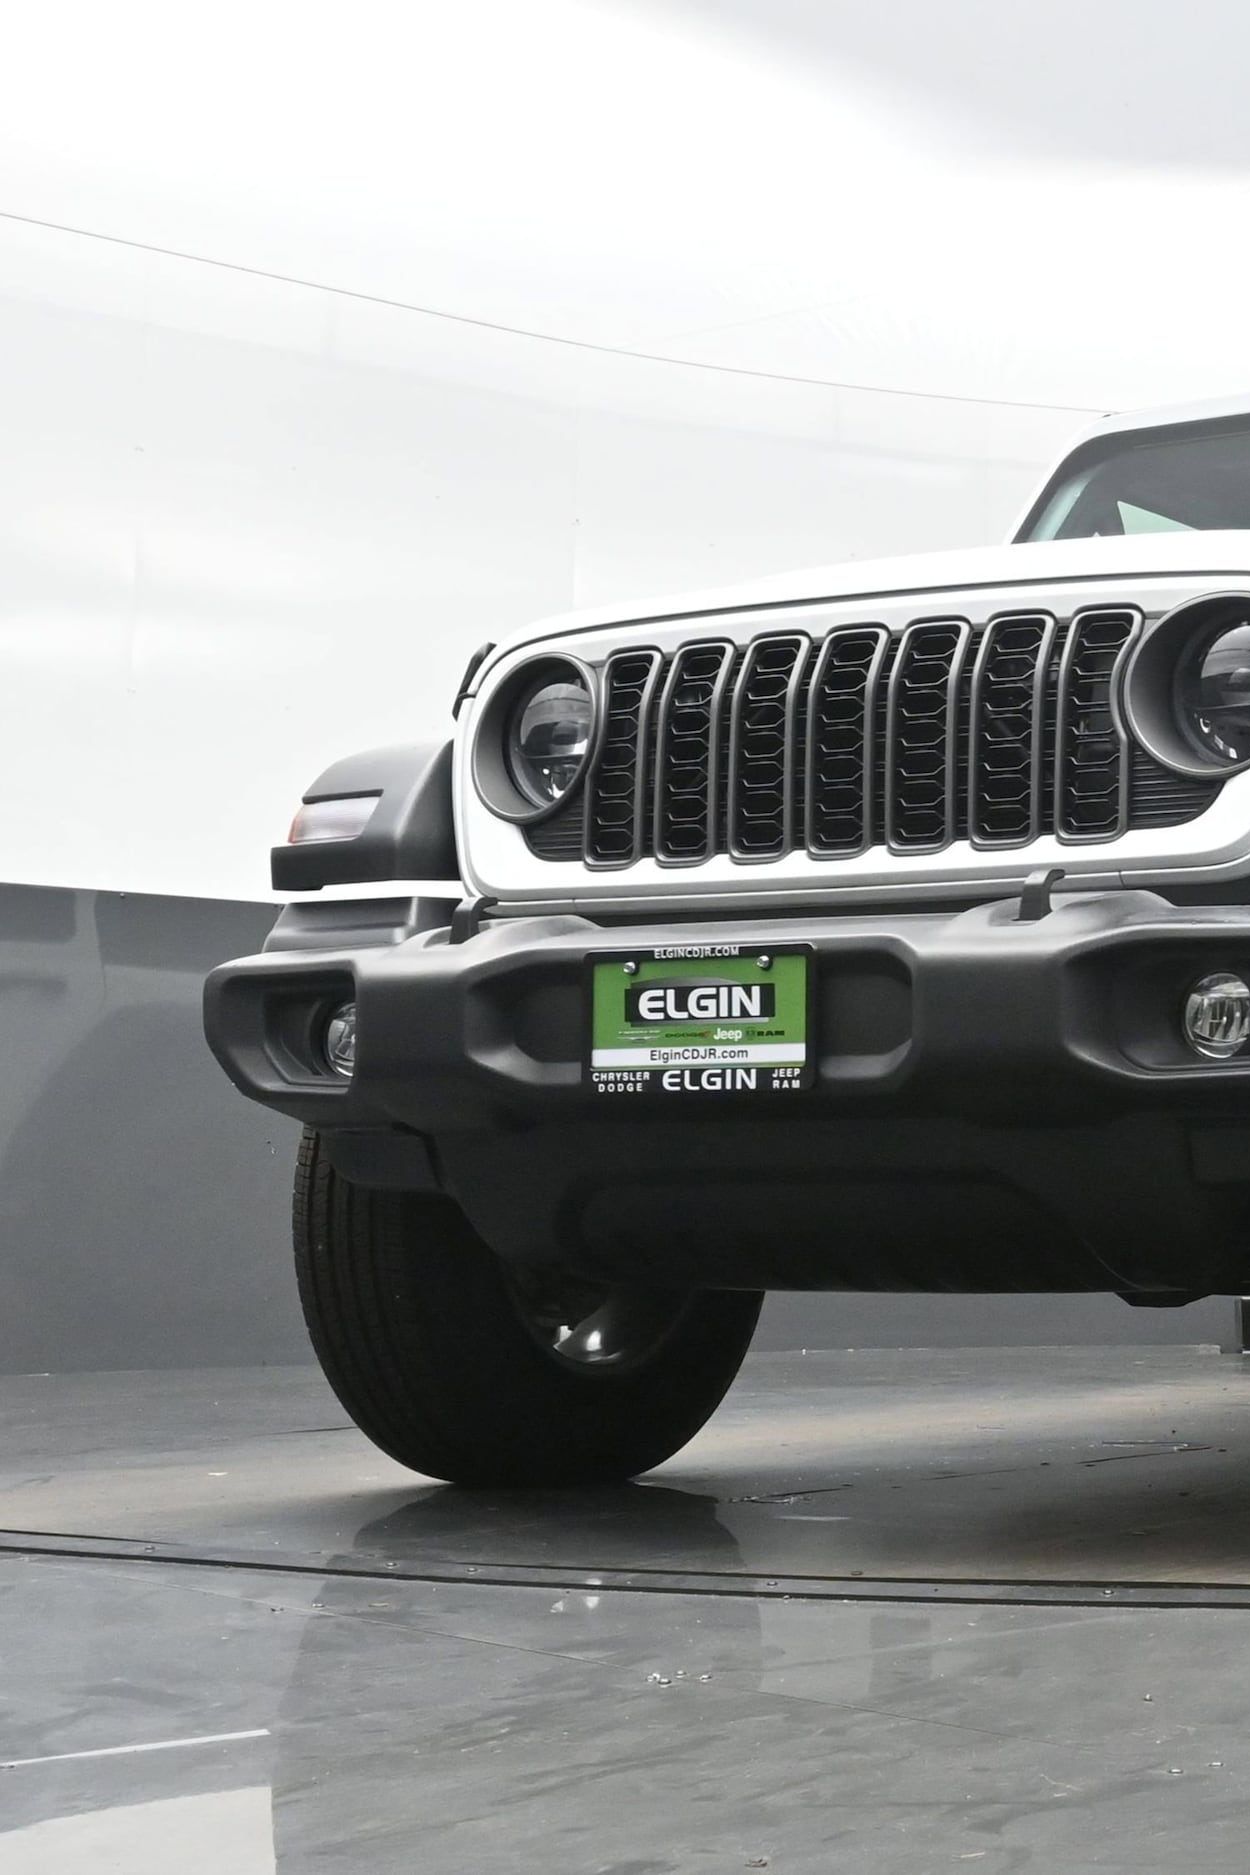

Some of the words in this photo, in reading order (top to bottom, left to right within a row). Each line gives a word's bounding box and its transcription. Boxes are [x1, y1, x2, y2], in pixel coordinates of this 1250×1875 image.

[653, 946, 740, 959] ELGINCDJR.COM
[638, 985, 761, 1020] ELGIN
[713, 1027, 742, 1041] Jeep
[650, 1048, 749, 1063] ElginCDJR.com
[592, 1072, 650, 1082] CHRYSLER
[662, 1068, 757, 1091] ELGIN
[772, 1068, 801, 1078] JEEP
[598, 1083, 643, 1092] DODGE
[773, 1079, 801, 1089] RAM
